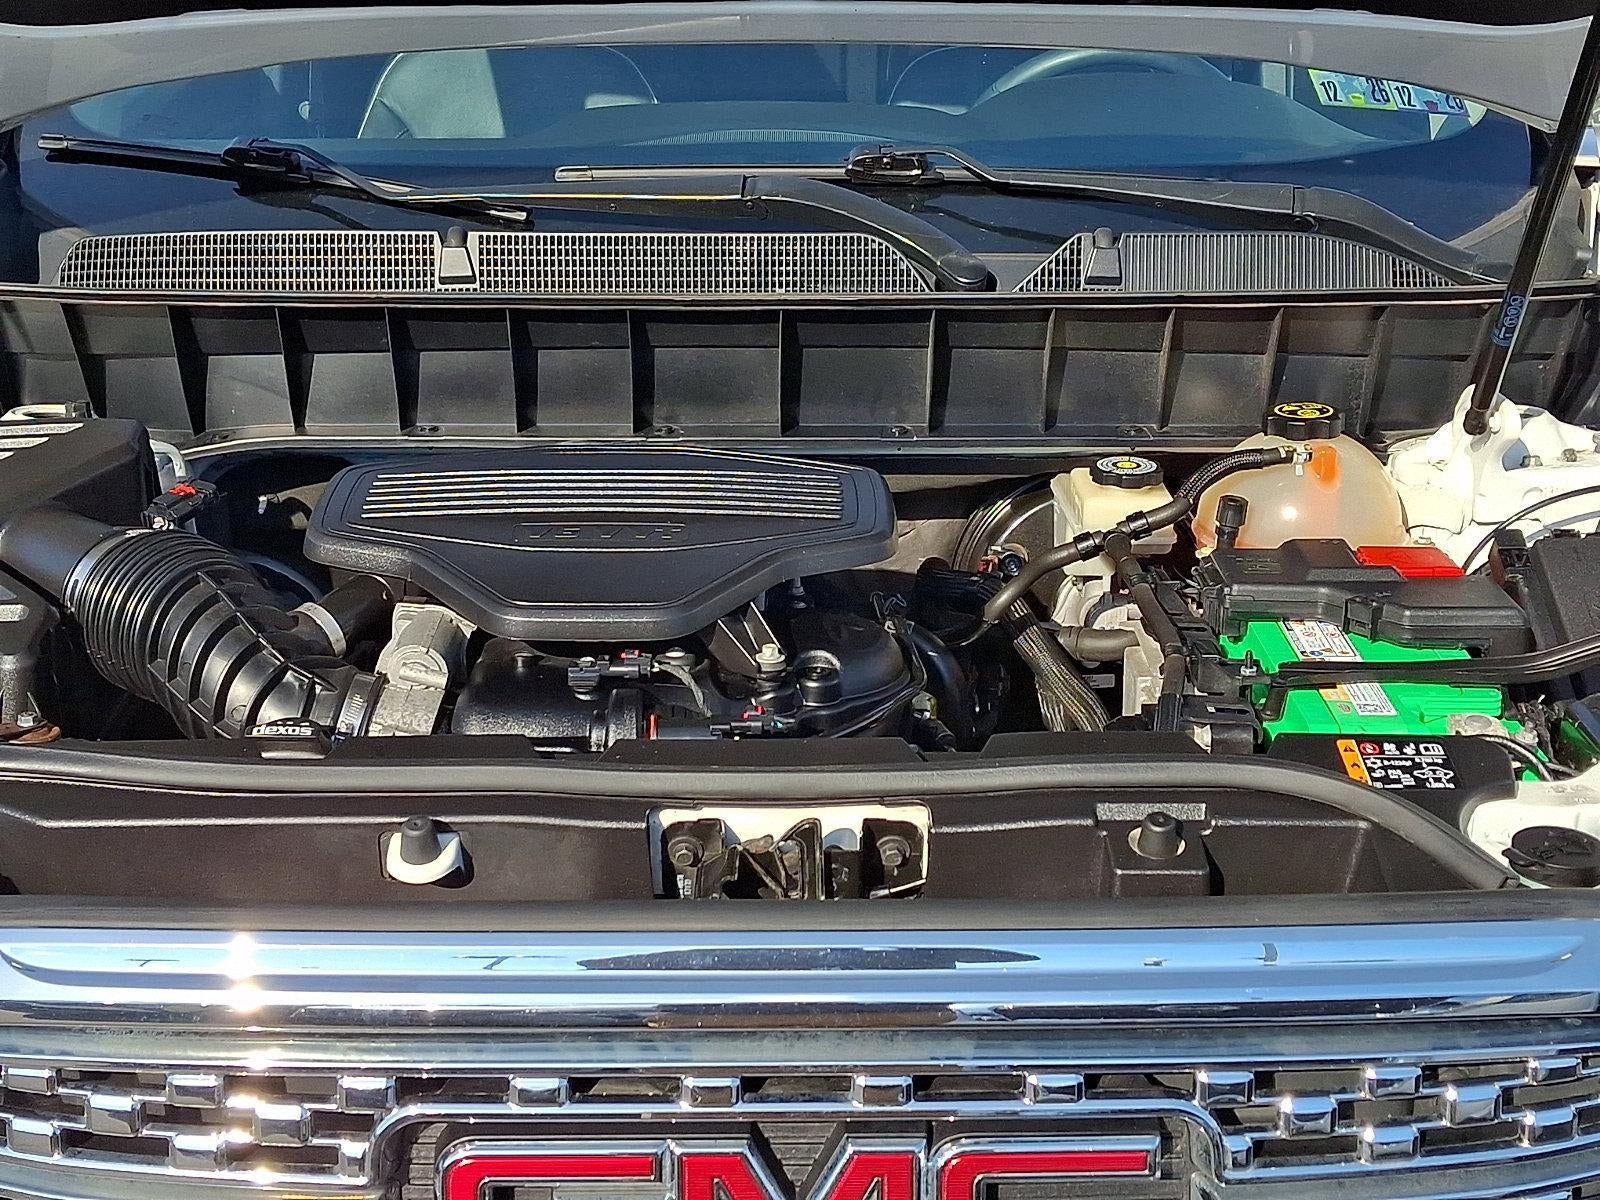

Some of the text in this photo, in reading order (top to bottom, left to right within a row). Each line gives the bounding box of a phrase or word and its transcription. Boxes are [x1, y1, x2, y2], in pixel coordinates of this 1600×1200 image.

[1319, 77, 1391, 104] 12 26
[1394, 85, 1417, 108] 12
[251, 724, 315, 736] dexos
